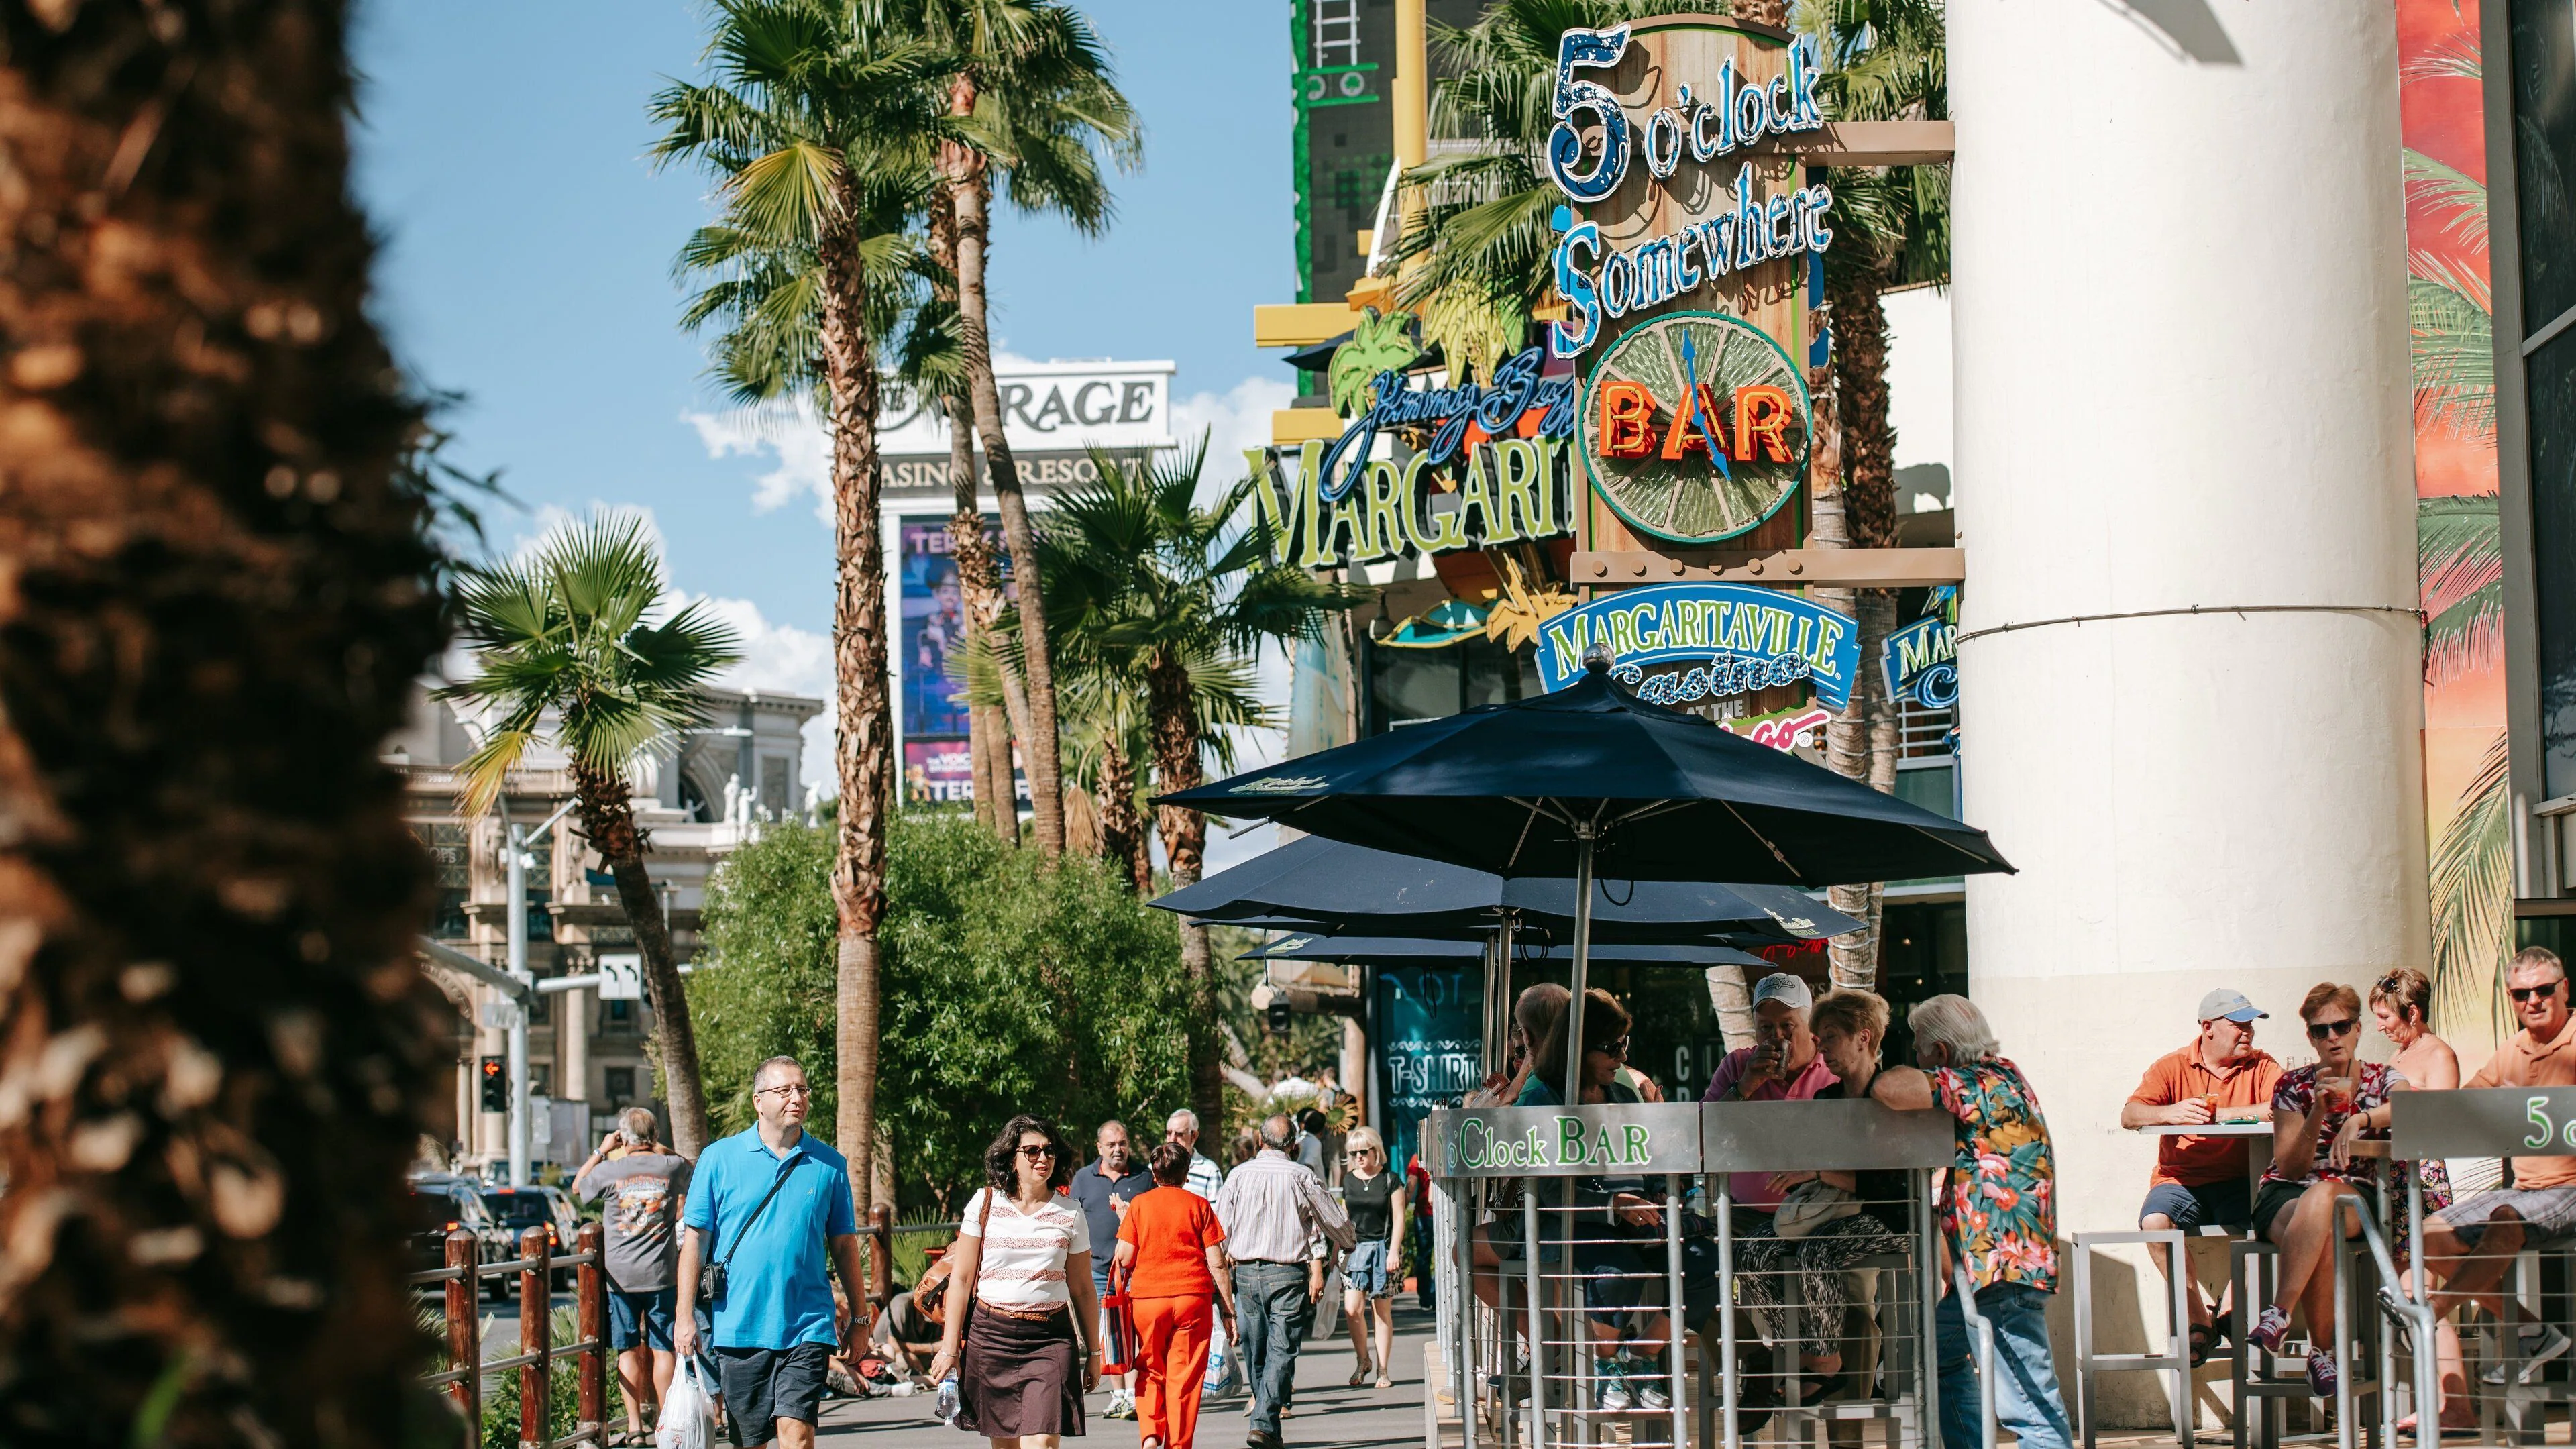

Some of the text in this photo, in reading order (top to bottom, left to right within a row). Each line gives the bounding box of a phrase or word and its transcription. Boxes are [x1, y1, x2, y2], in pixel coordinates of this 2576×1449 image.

[1547, 23, 1823, 202] 5 o'clock
[1551, 162, 1833, 360] Somewhere
[1000, 381, 1155, 433] RAGE
[1318, 370, 1480, 502] Jimmy
[1599, 380, 1794, 463] BAR
[881, 461, 953, 488] ASIN
[1018, 458, 1142, 485] RESOT
[1549, 599, 1844, 681] MARGARITAVILLE
[1710, 700, 1743, 720] THE
[1554, 1115, 1652, 1166] BAR
[2524, 1095, 2554, 1149] 5
